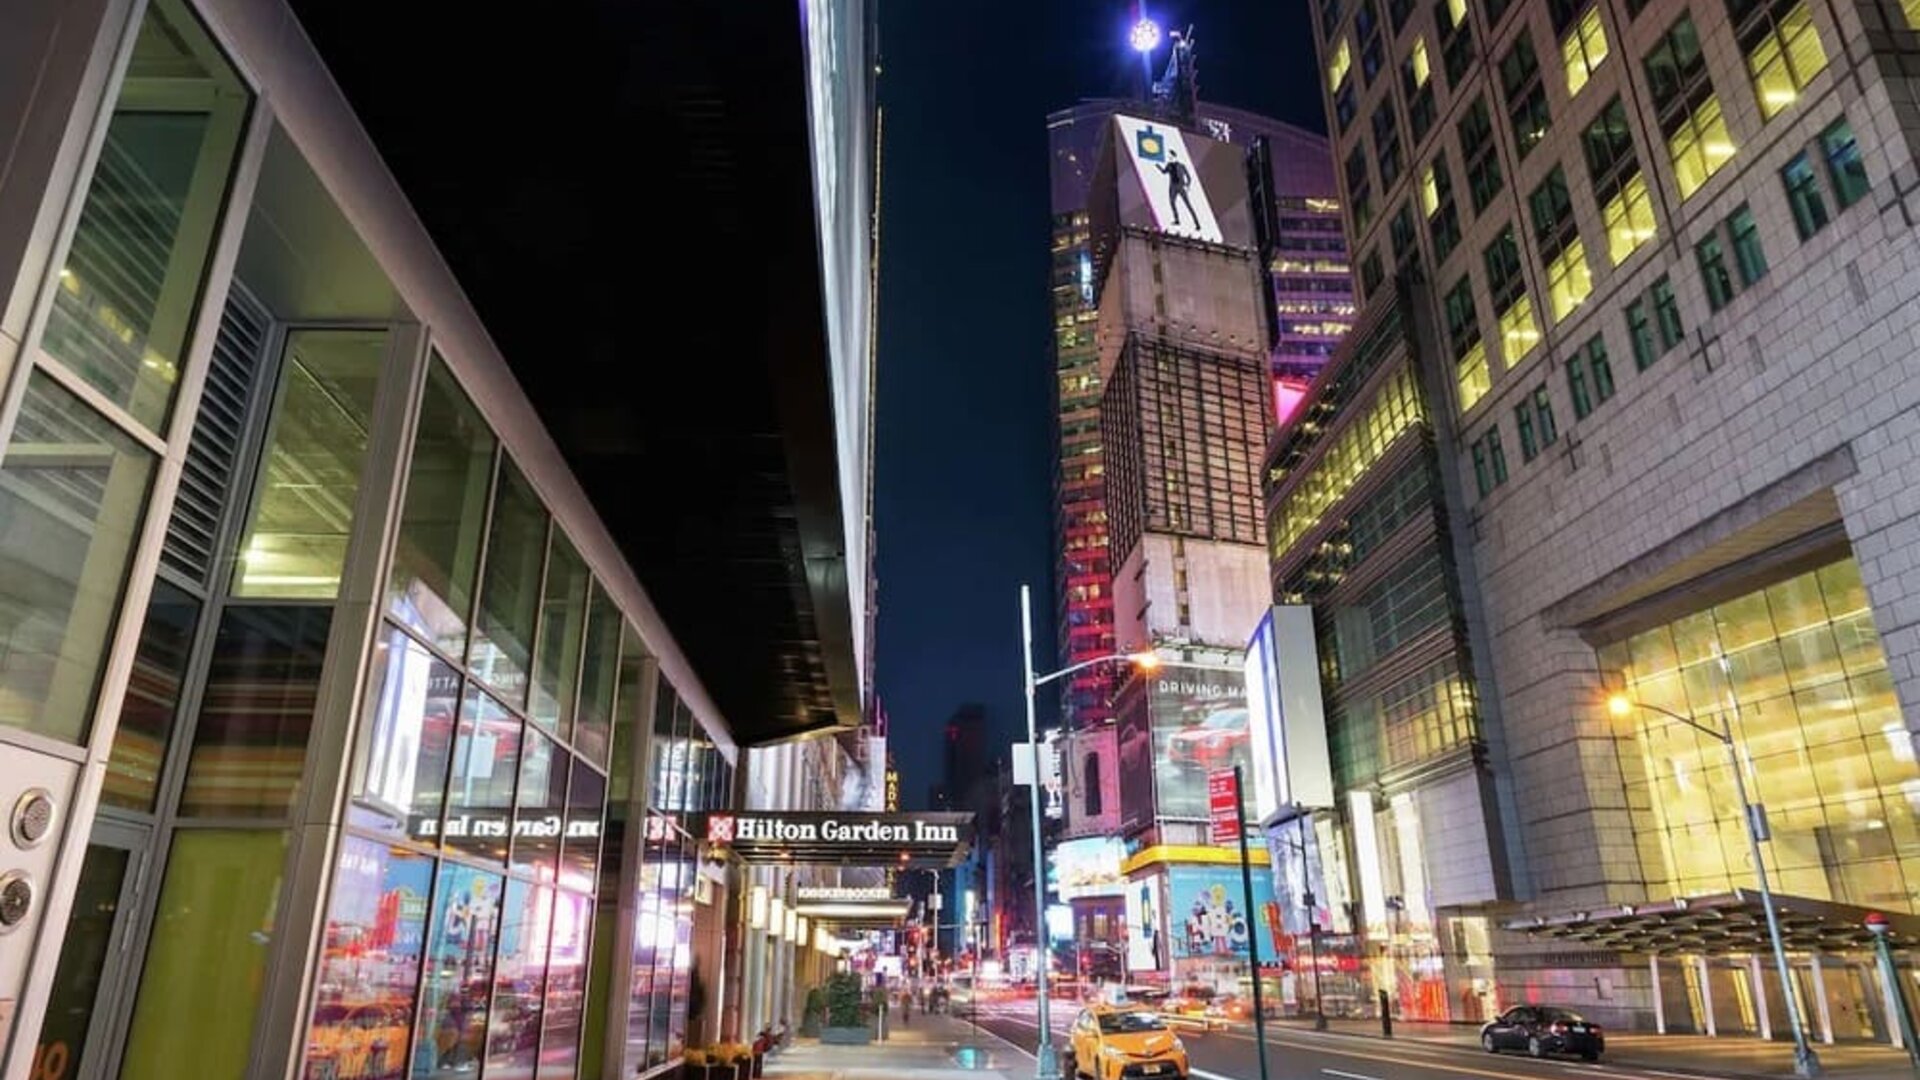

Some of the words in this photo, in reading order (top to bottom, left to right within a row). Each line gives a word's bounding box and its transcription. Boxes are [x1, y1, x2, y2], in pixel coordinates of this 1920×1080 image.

[1158, 680, 1222, 698] DRIVING
[736, 818, 816, 840] Hilton
[821, 819, 909, 841] Garden
[915, 821, 958, 842] Inn
